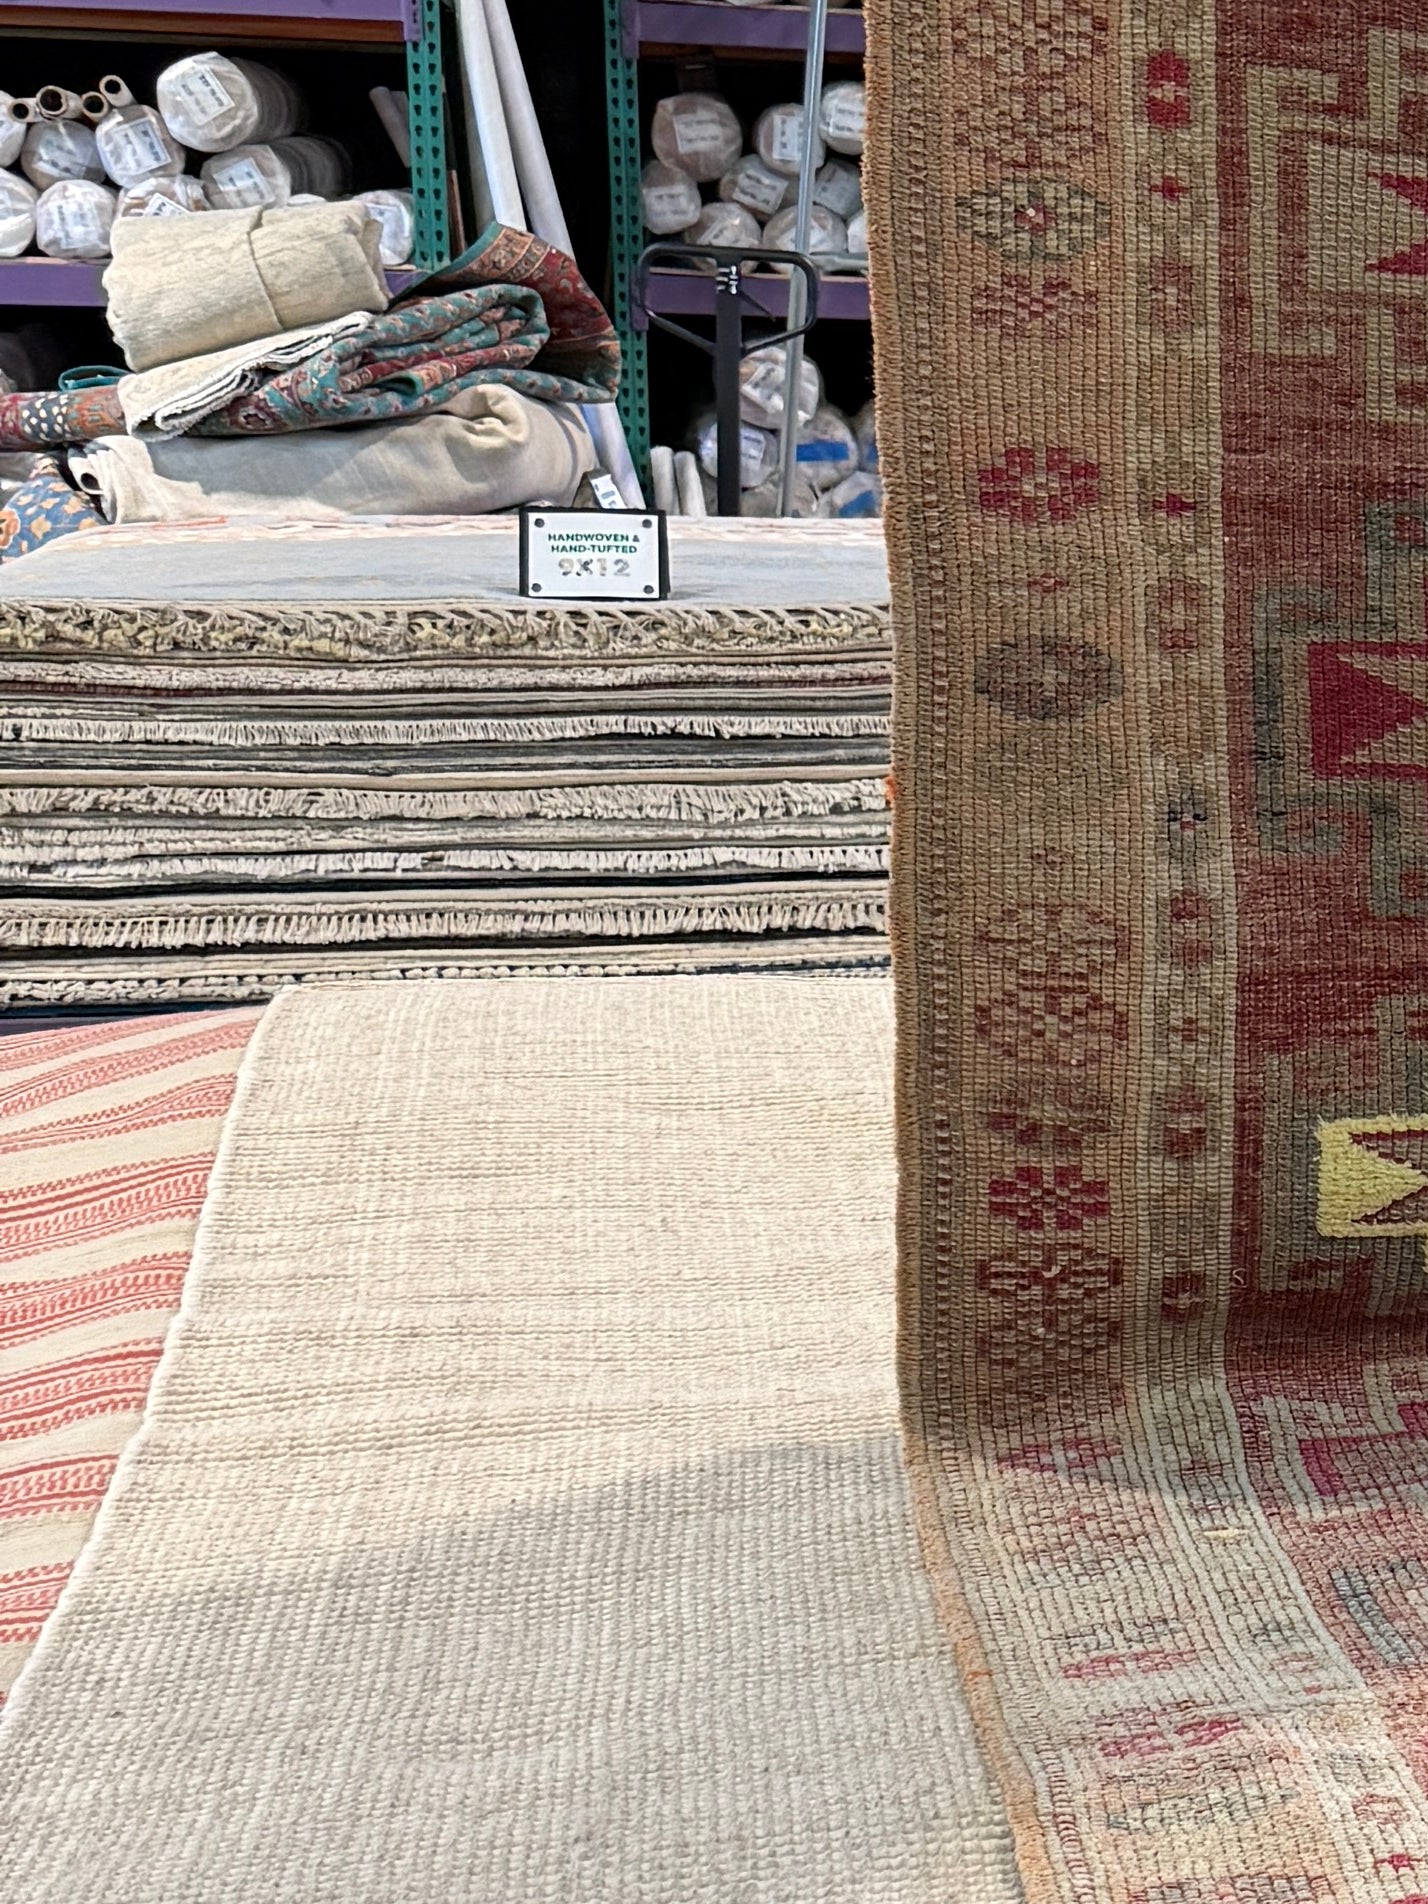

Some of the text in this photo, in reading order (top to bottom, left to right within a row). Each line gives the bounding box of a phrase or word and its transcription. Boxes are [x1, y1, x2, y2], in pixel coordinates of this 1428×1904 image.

[548, 533, 640, 542] HANDWOVEN &
[551, 545, 638, 554] HAND-TUFTED
[558, 557, 631, 577] 9X12
